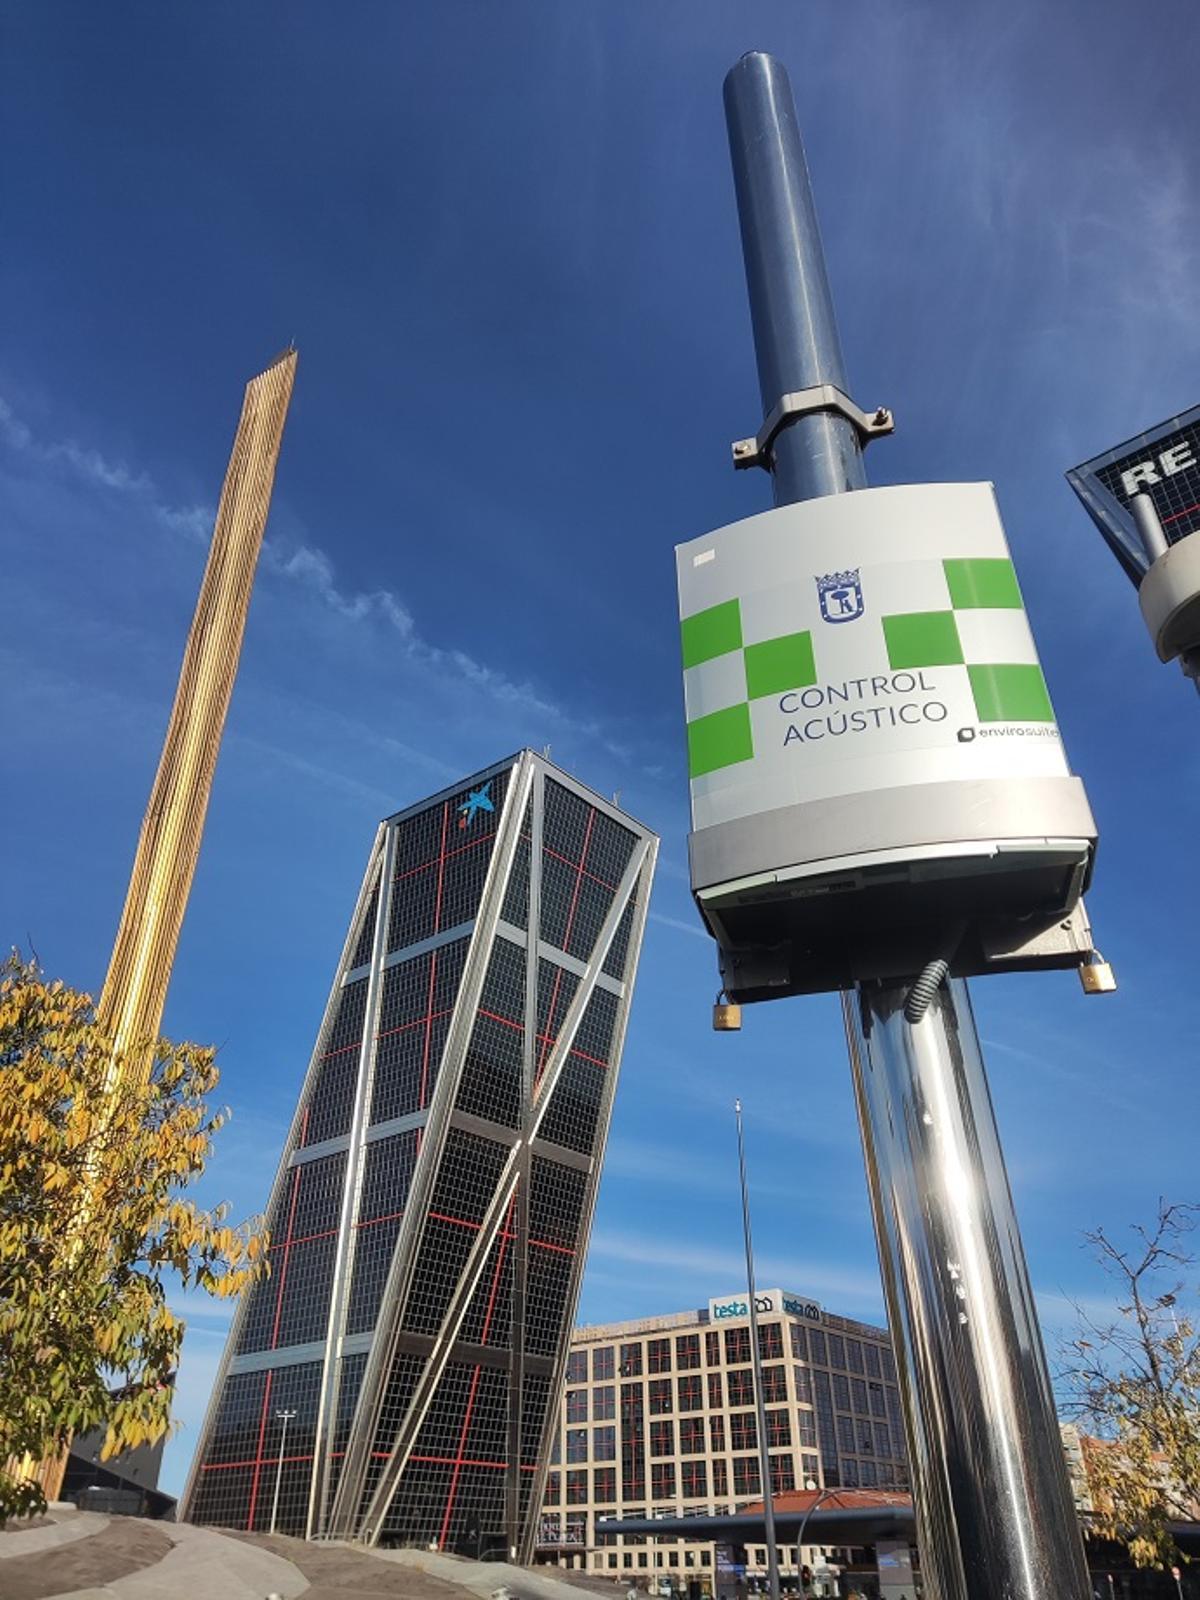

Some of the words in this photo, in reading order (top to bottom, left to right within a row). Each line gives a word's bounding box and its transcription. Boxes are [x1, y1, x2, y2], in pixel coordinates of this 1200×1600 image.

[1121, 441, 1197, 495] RE
[779, 672, 936, 714] CONTROL
[783, 702, 948, 746] ACÚSTICO
[979, 726, 1060, 738] envirosuite
[714, 1302, 748, 1319] testa
